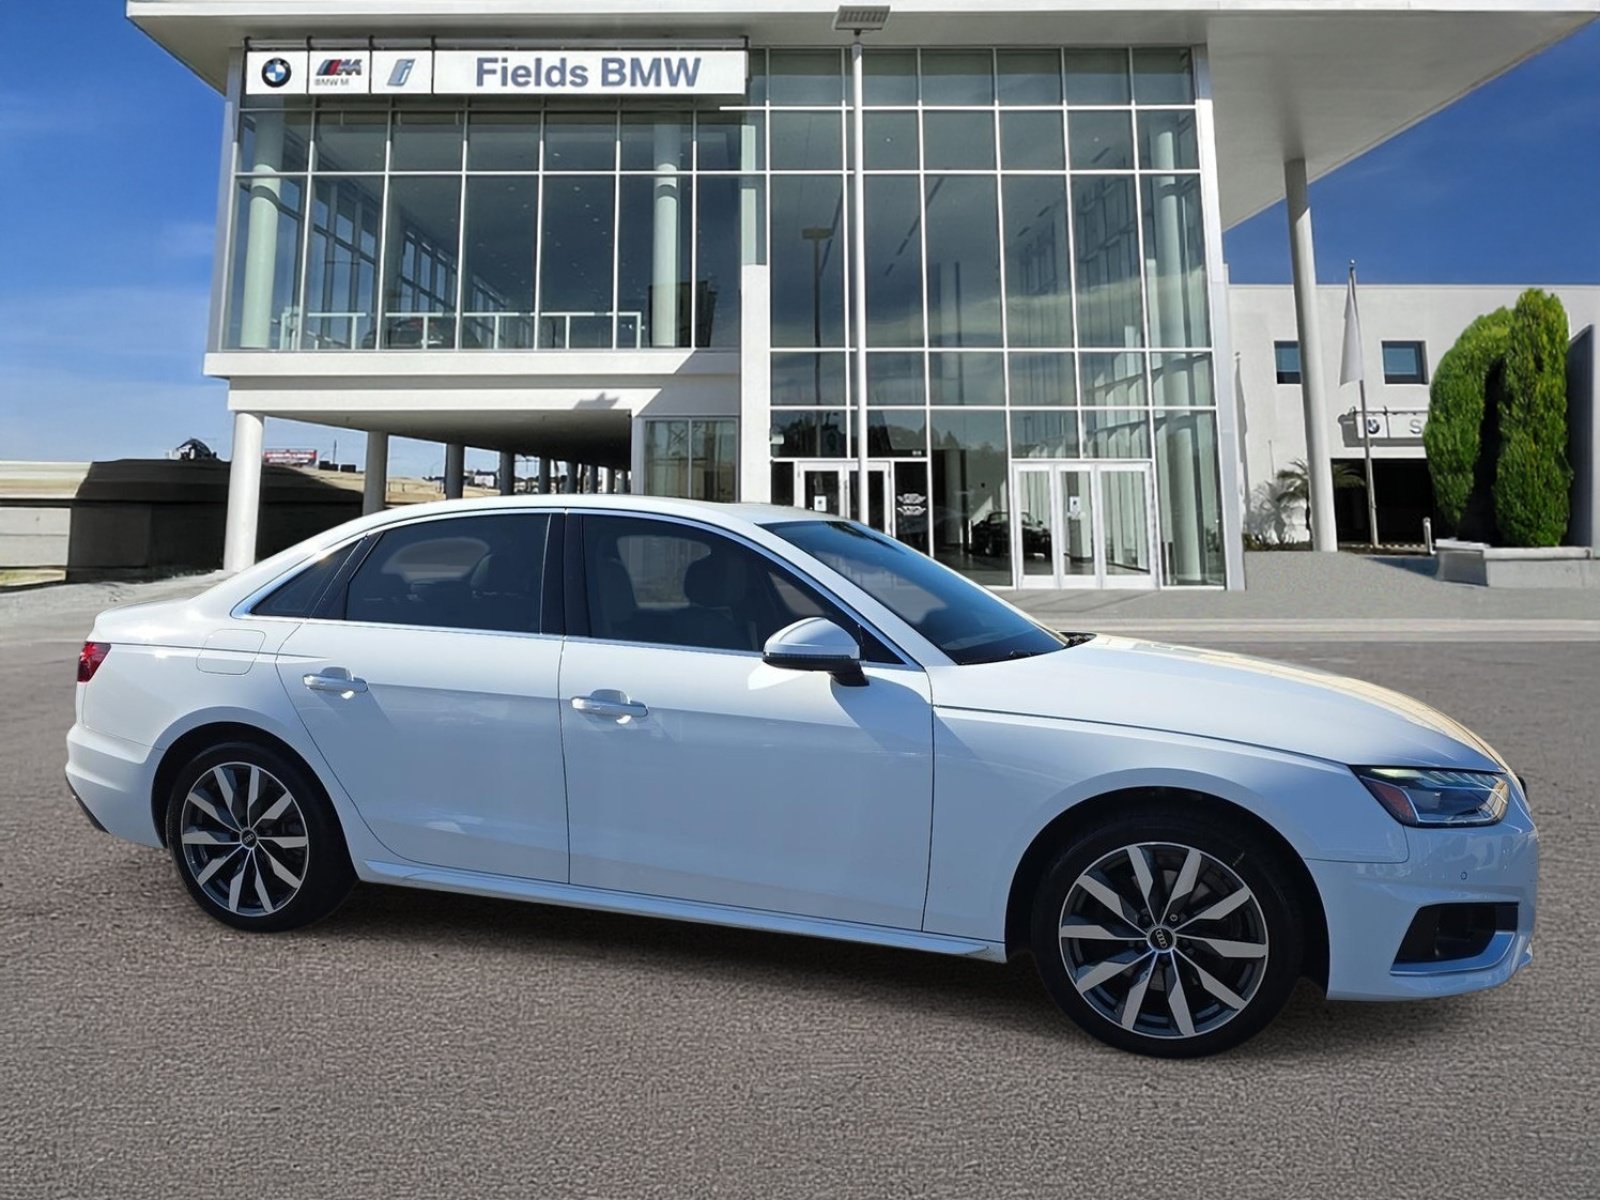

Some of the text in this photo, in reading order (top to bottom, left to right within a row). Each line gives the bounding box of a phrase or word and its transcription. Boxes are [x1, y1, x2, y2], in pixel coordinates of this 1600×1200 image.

[315, 78, 338, 86] BMW
[476, 57, 702, 88] Fields BMW
